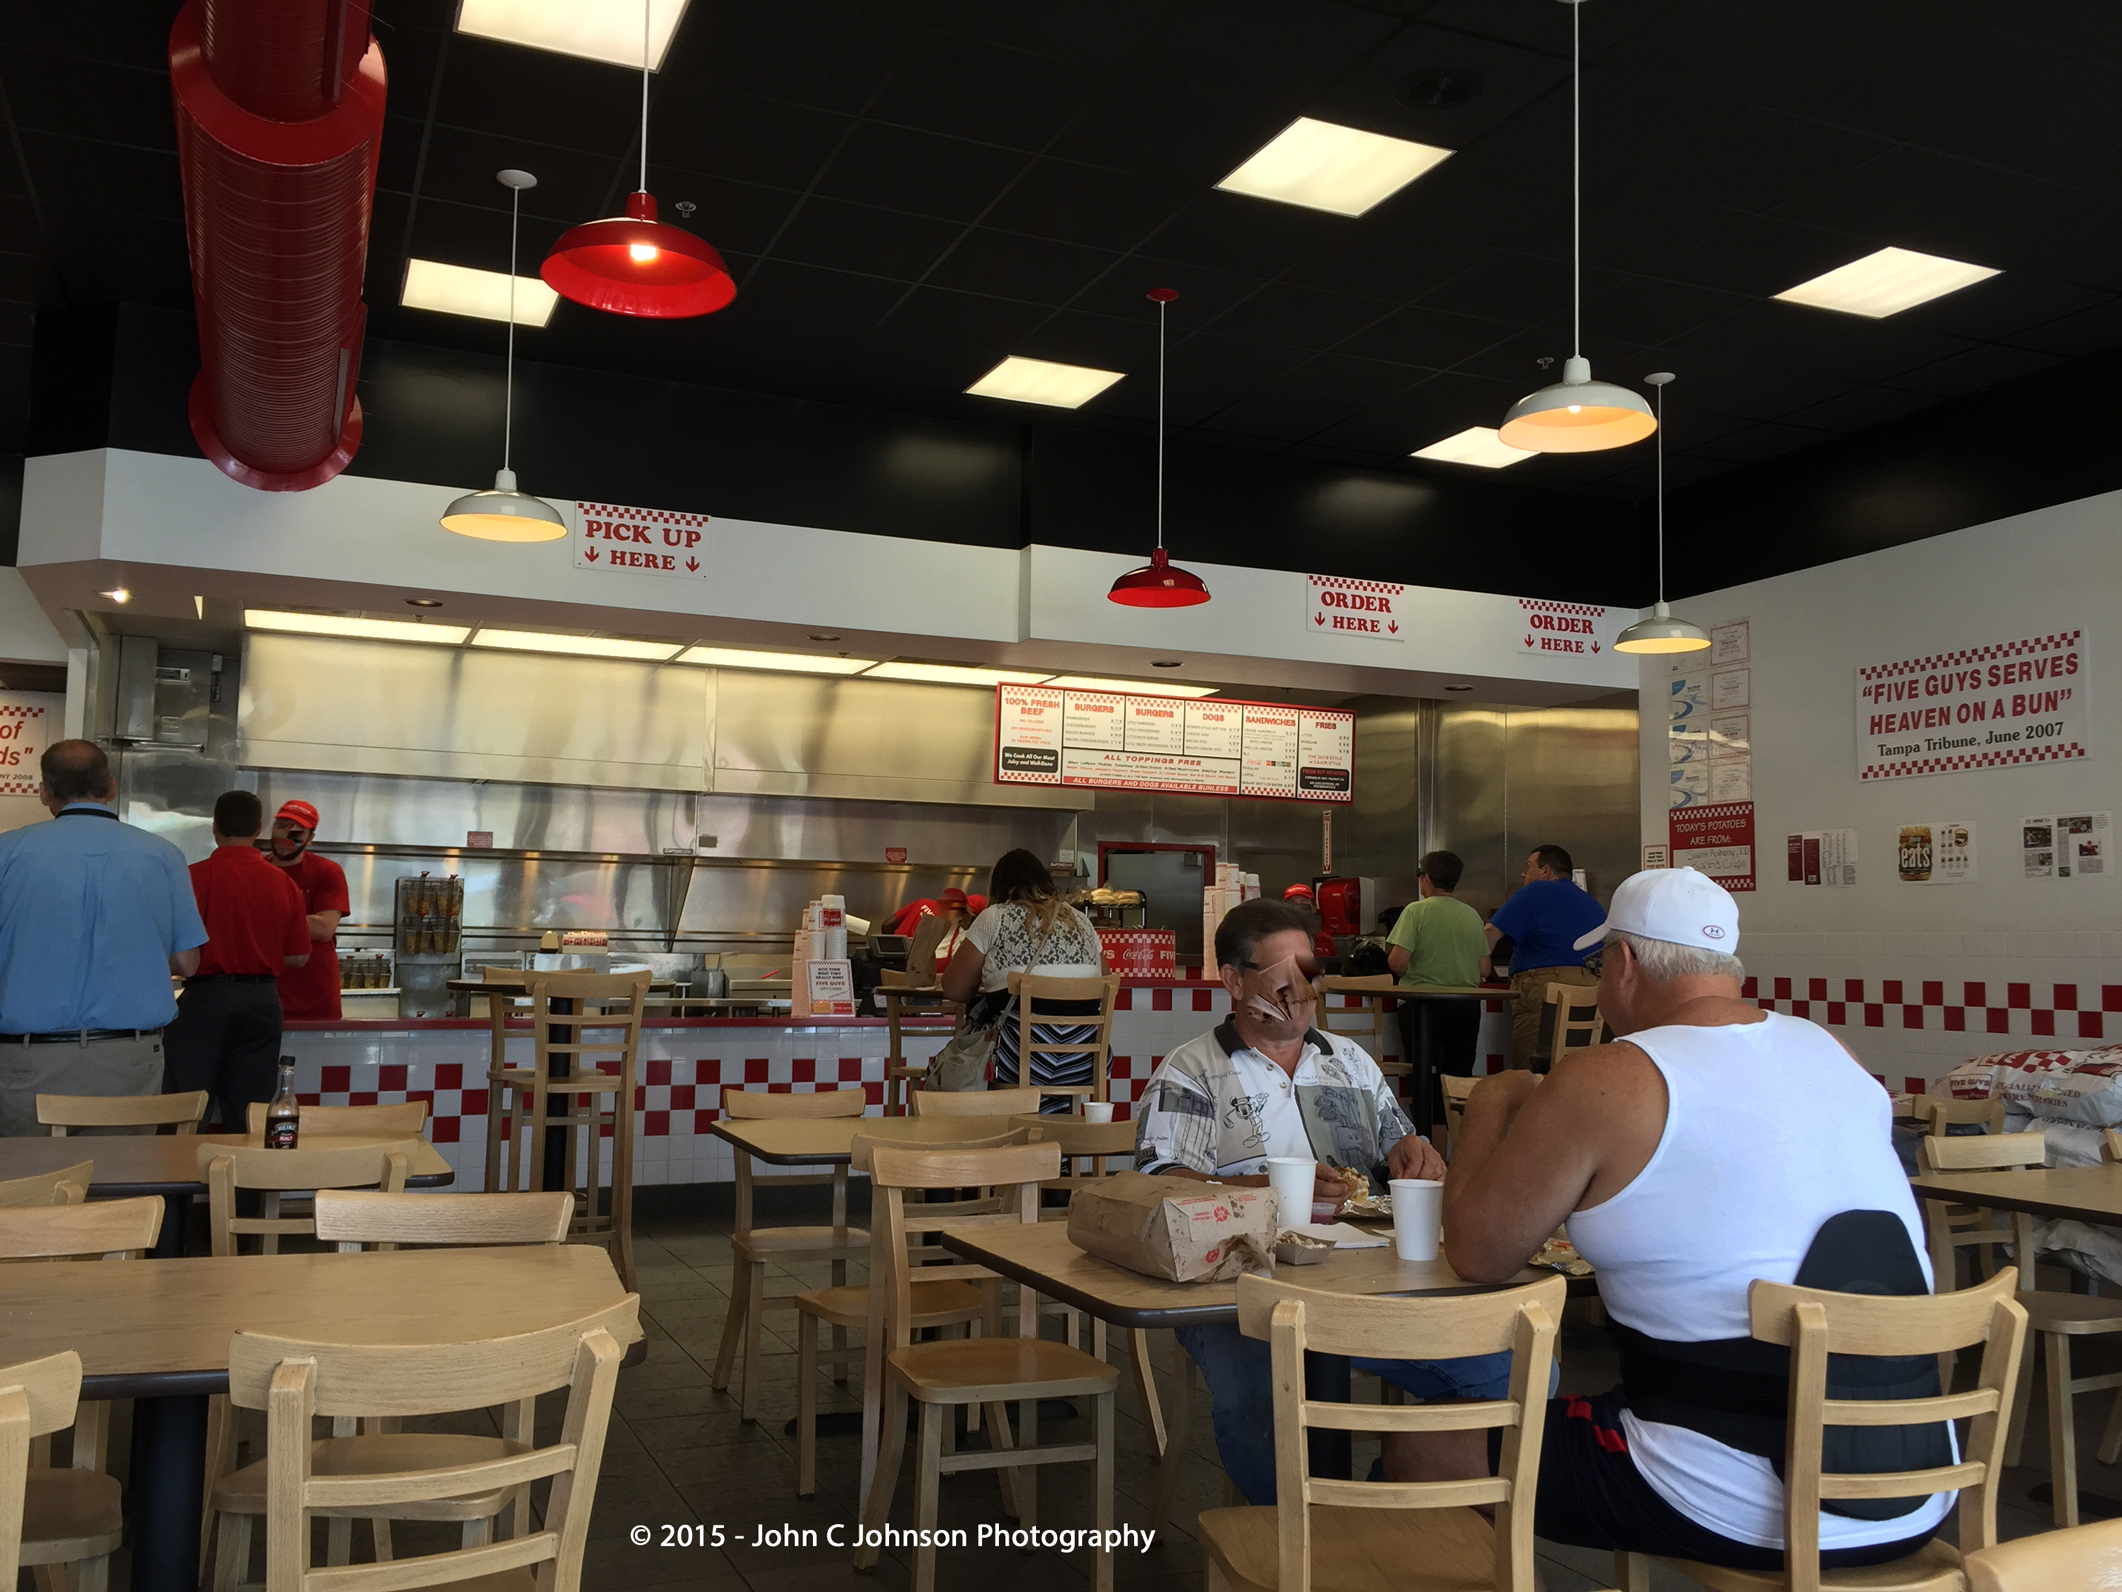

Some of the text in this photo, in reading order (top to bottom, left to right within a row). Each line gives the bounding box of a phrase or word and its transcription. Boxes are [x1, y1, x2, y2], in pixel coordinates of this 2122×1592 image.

[585, 519, 701, 548] PICK UP
[610, 550, 675, 570] HERE
[1321, 591, 1391, 613] ORDER
[1333, 616, 1380, 633] HERE
[1530, 614, 1594, 634] ORDER
[1541, 638, 1584, 653] HERE
[1925, 669, 1981, 696] GUYS
[1988, 653, 2078, 687] SERVES
[1005, 697, 1060, 708] 100% FRESH
[1075, 703, 1114, 713] BURGERS
[1021, 707, 1044, 715] BEEF
[1135, 708, 1174, 718] BURGERS
[1203, 713, 1224, 721] DOGS
[1870, 706, 1950, 735] HEAVEN
[1957, 701, 1986, 723] ON
[1992, 699, 2005, 719] A
[1245, 716, 1296, 727] SANDWICHES
[1315, 722, 1336, 730] FRIES
[0, 720, 24, 740] of
[1878, 722, 2064, 757] Tampa Tribune, June 2007
[1126, 756, 1174, 764] TOPPINGS
[1676, 819, 1746, 833] TODAY'S POTATOES
[1690, 835, 1731, 845] ARE FROM:
[1901, 842, 1930, 868] eats
